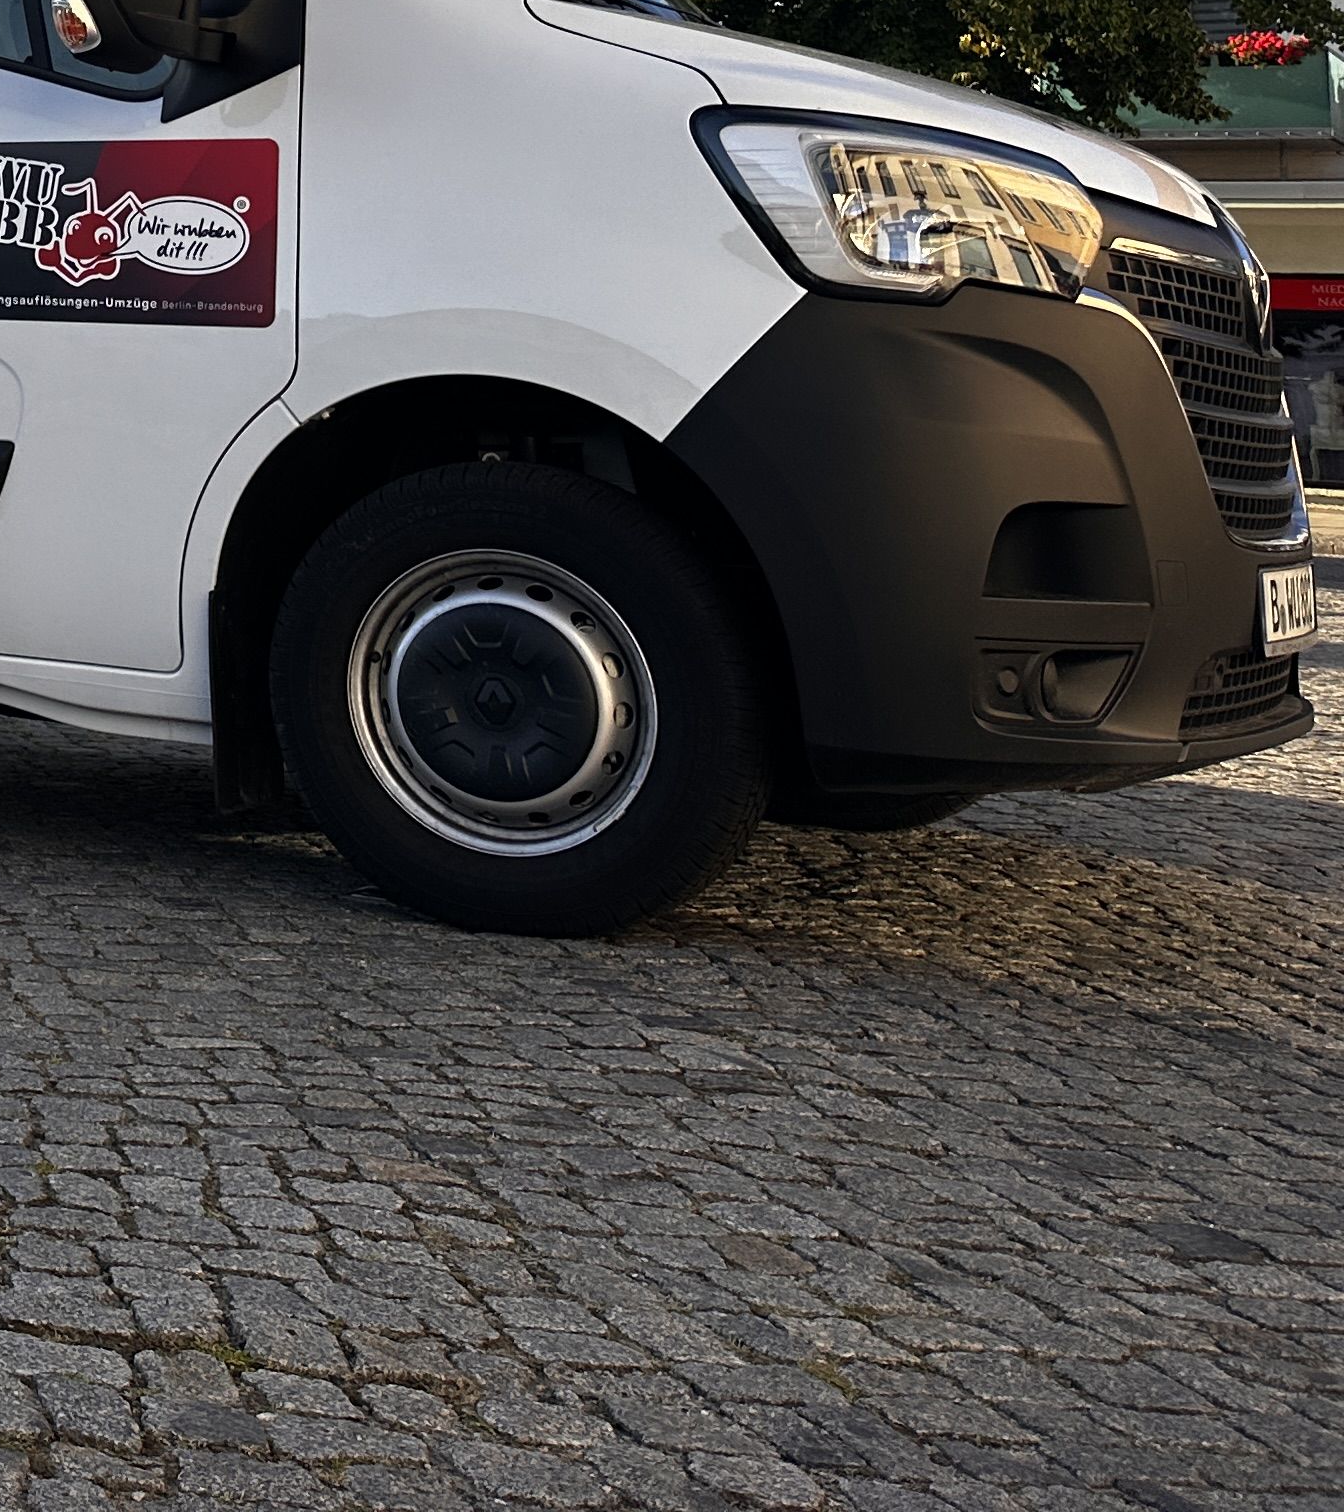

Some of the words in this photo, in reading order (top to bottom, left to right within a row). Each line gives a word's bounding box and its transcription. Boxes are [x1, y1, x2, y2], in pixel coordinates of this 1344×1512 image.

[137, 215, 172, 236] Wir
[156, 240, 209, 262] dit!!!
[1270, 579, 1280, 633] B
